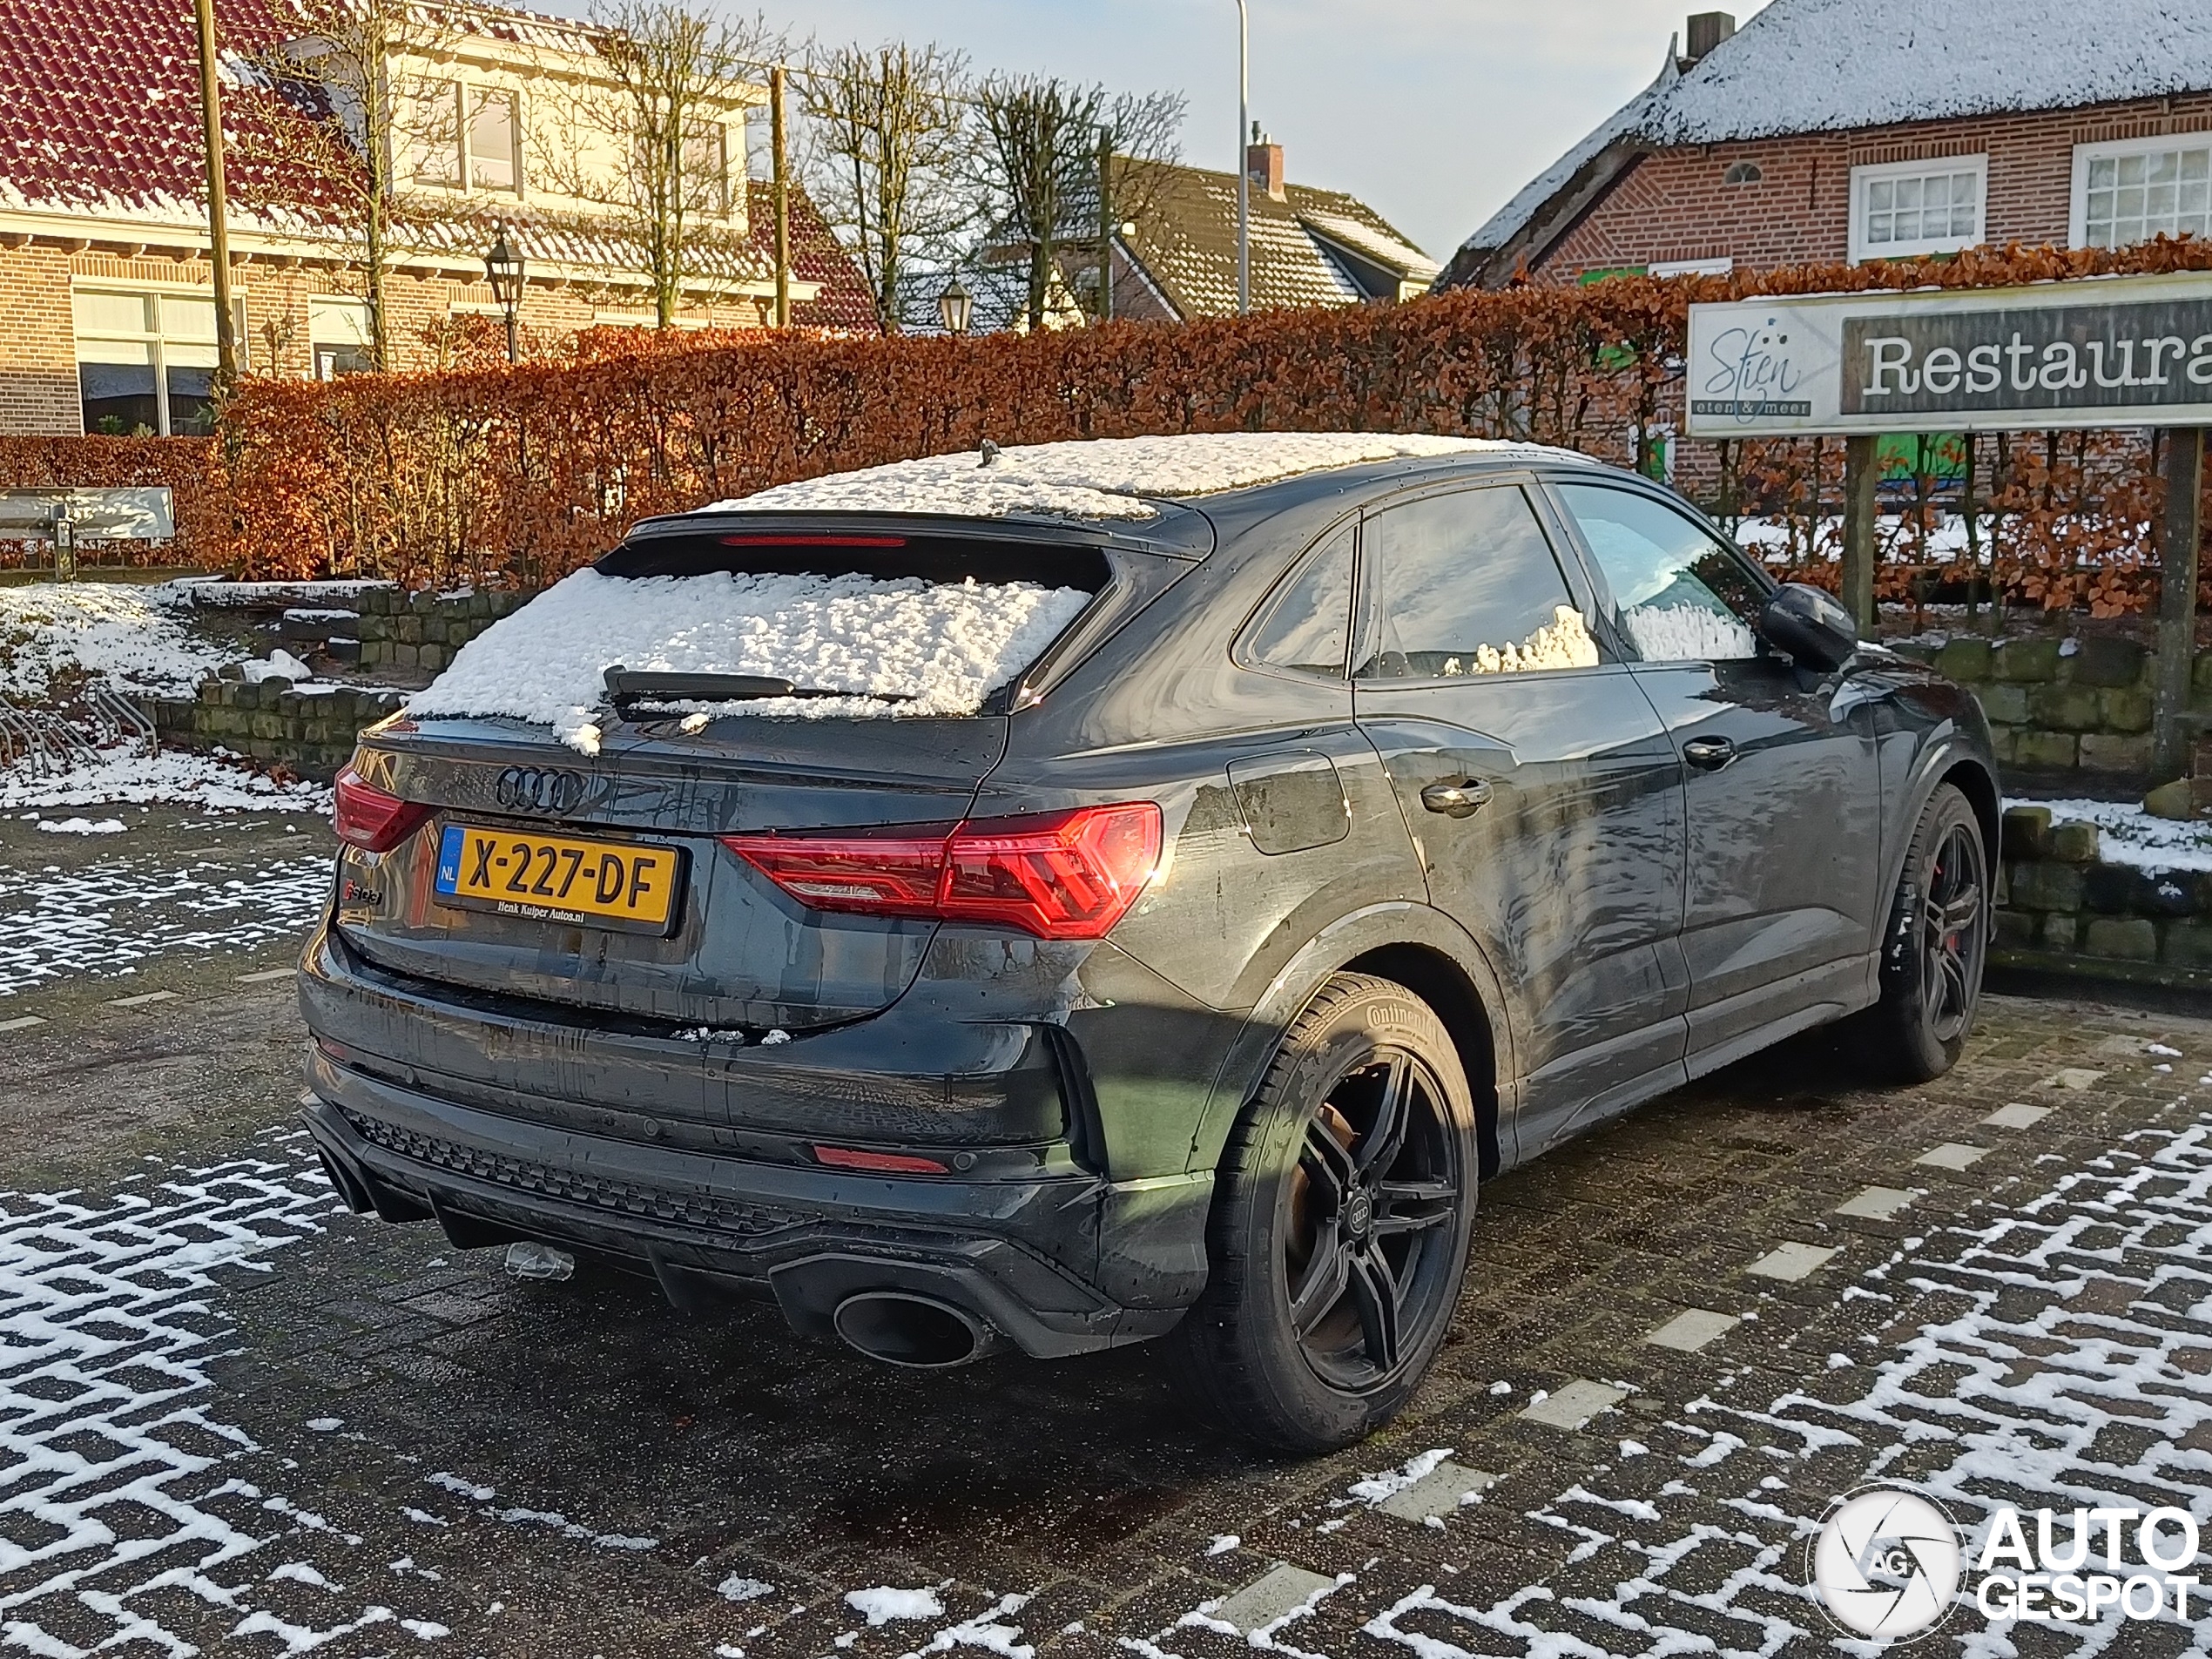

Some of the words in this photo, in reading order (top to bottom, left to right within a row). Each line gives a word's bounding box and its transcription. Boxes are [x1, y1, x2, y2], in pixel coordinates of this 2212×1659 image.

[1862, 333, 2212, 395] Restaura
[1696, 401, 1734, 413] eten
[1742, 401, 1754, 413] &
[1764, 402, 1811, 414] meer
[441, 866, 455, 881] NL
[469, 839, 657, 907] X-227-DF
[497, 901, 520, 914] Henk
[520, 905, 548, 919] Kuiper
[549, 909, 584, 923] Autos.nl
